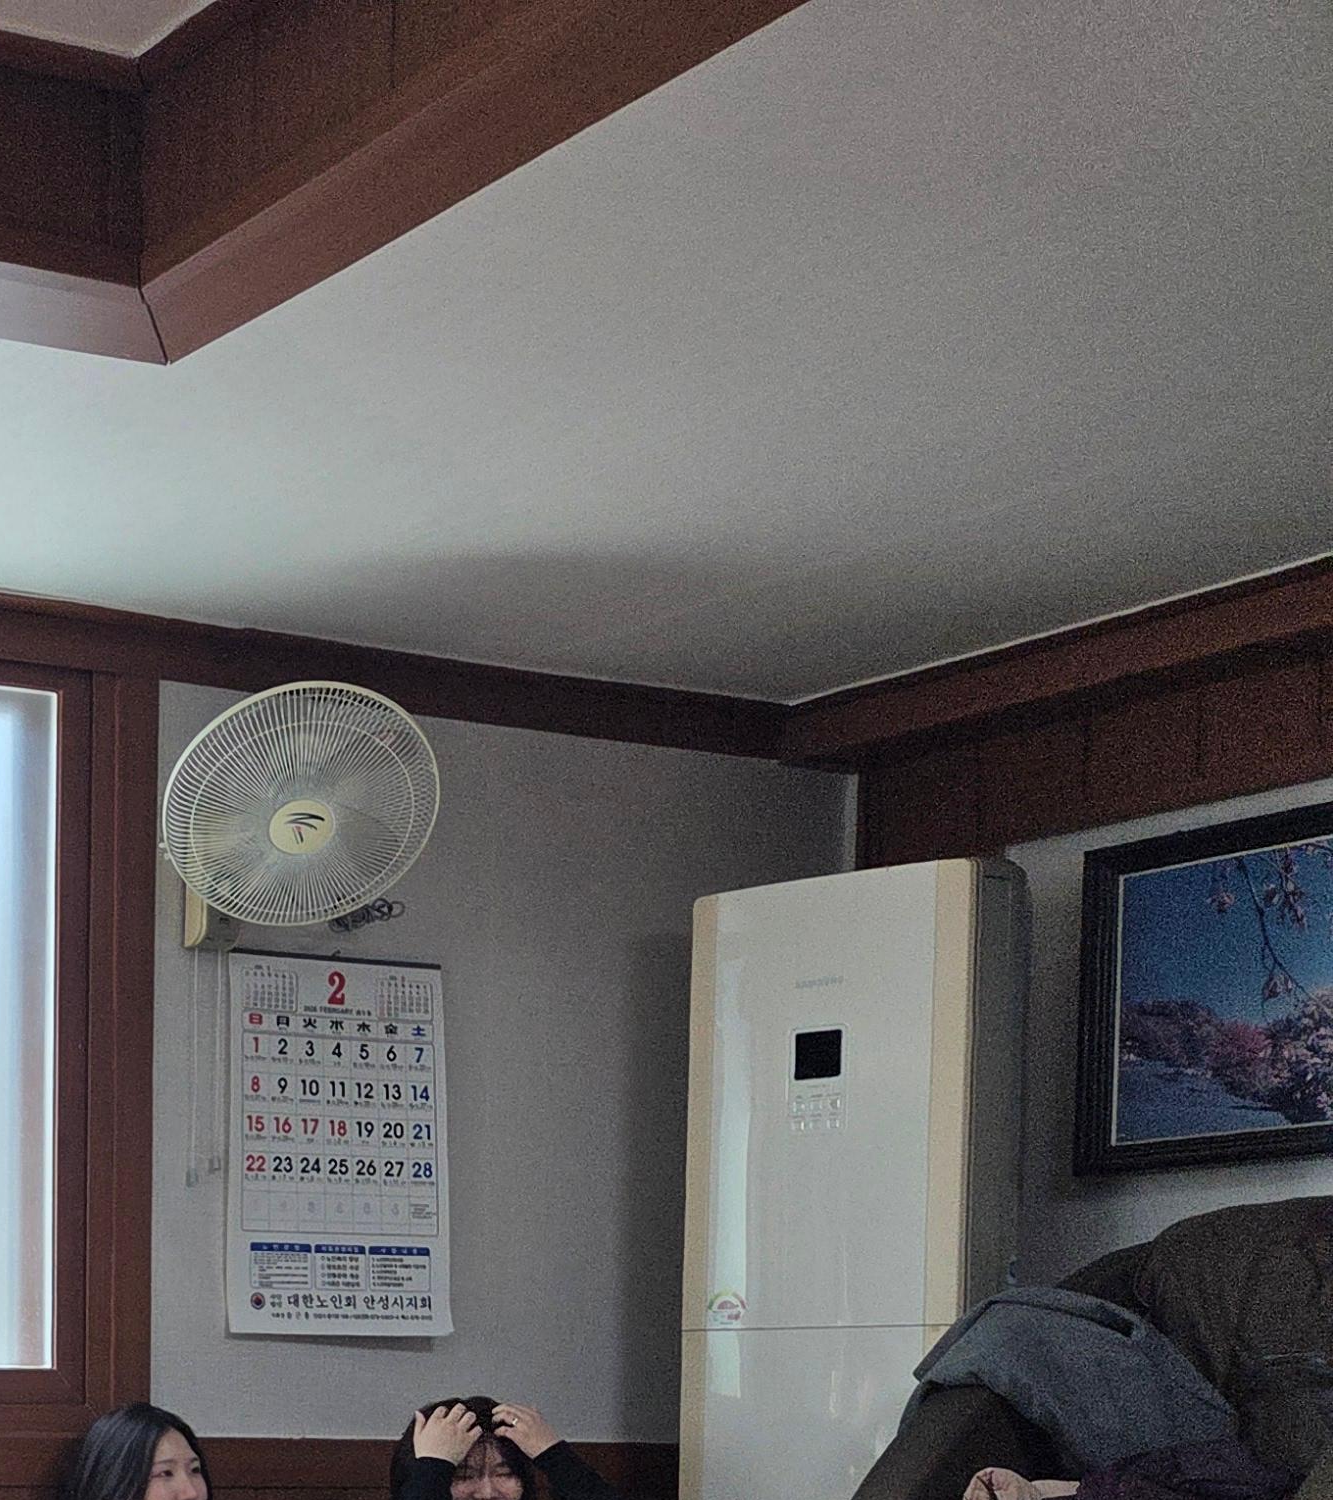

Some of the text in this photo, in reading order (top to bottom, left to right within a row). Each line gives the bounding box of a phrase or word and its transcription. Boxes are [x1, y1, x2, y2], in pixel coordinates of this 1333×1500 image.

[327, 970, 346, 1006] 2
[303, 1017, 317, 1029] 火
[329, 1020, 344, 1030] 水
[356, 1022, 371, 1033] 木
[384, 1023, 398, 1035] 金
[411, 1025, 426, 1037] 土
[253, 1037, 424, 1063] 1 2 3 4 5 6 7
[251, 1076, 430, 1102] 8 9 10 11 12 13 14
[247, 1115, 431, 1140] 15 16 17 18 19 20 21
[246, 1155, 433, 1178] 22 23 24 25 26 27 28
[287, 1293, 432, 1311] 대한노인회 안성시지회
